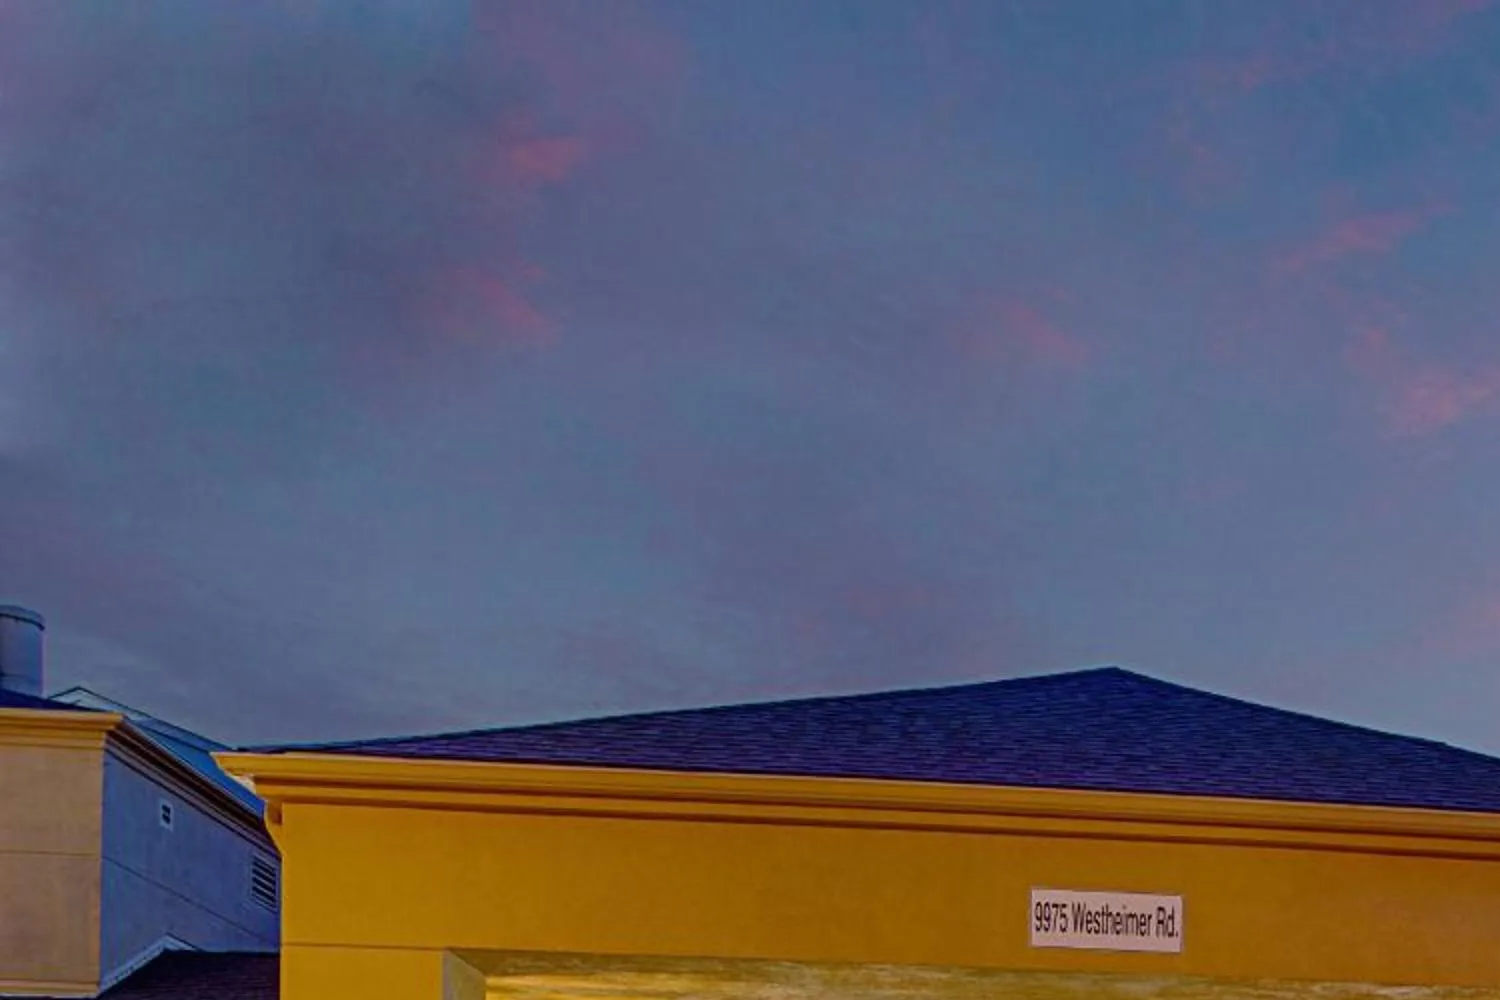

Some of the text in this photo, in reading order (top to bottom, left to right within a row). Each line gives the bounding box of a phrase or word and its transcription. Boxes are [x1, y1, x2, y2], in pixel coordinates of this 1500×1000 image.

[1034, 901, 1179, 938] 9975 Westheimer Rd.
